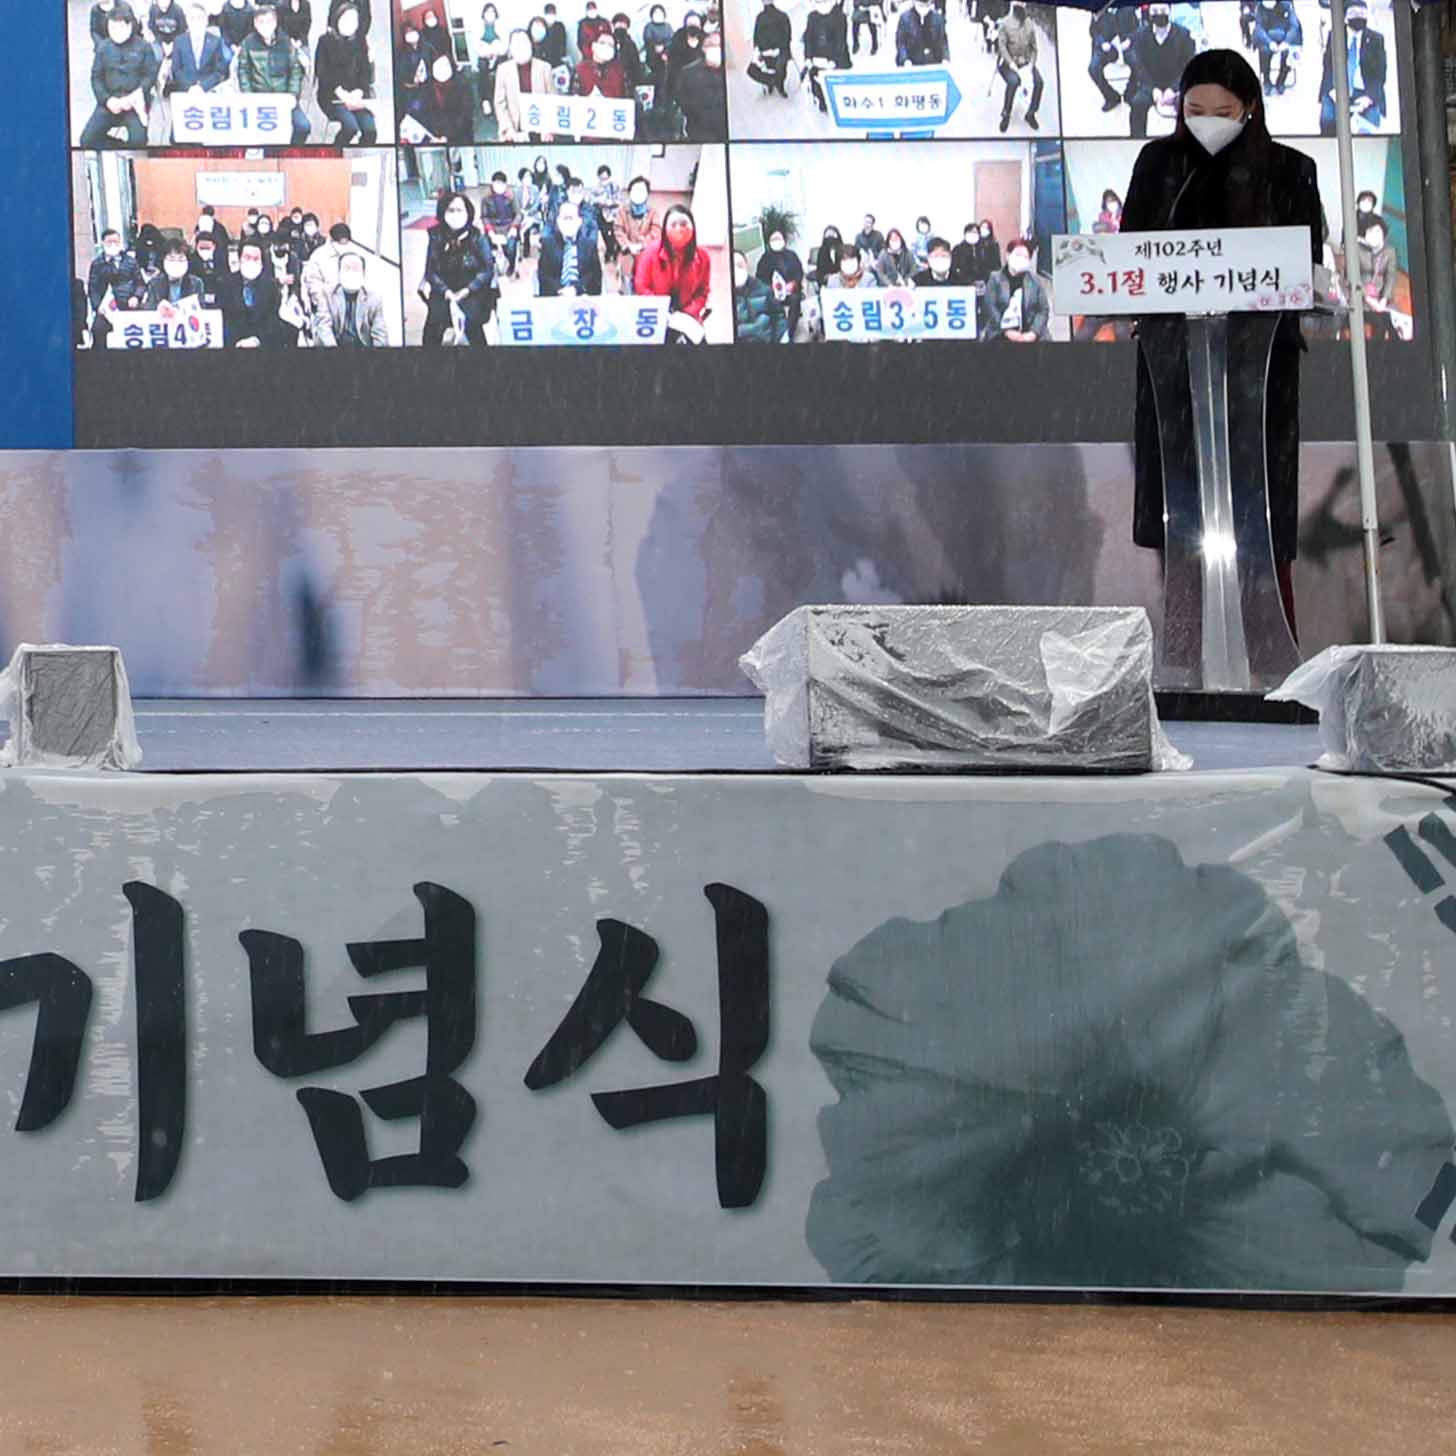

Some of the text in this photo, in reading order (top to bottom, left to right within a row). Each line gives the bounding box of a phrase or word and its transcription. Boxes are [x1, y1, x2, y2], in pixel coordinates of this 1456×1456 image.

[182, 105, 279, 132] 송림1동
[1134, 237, 1224, 260] 제102주년
[1080, 266, 1281, 297] 3.1절 행사 기념식
[509, 307, 660, 342] 금창동
